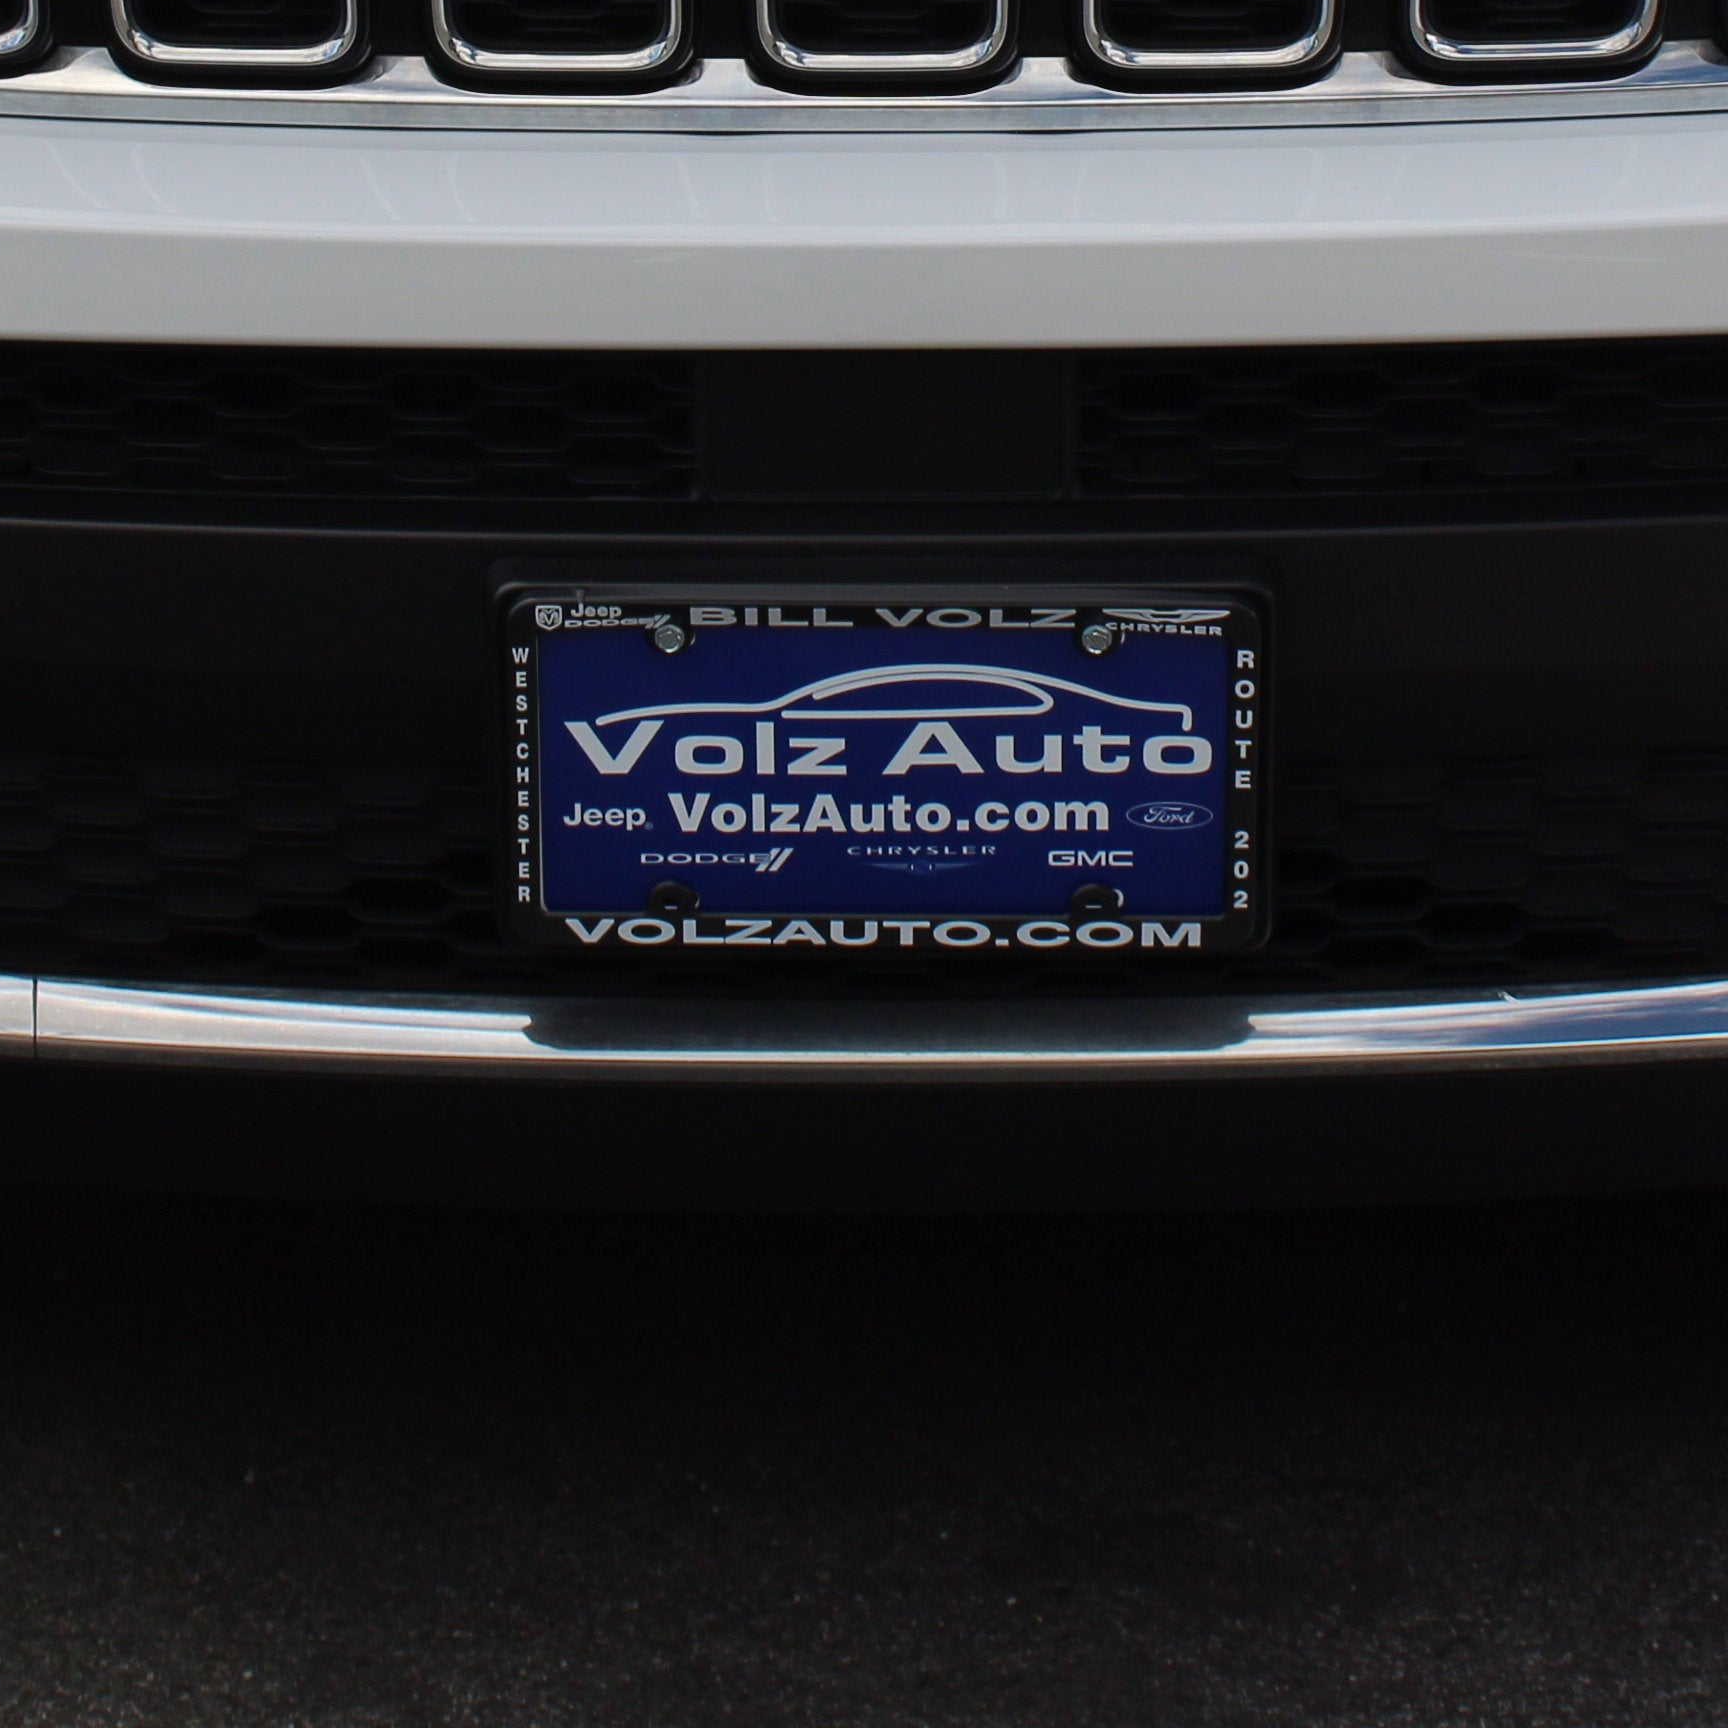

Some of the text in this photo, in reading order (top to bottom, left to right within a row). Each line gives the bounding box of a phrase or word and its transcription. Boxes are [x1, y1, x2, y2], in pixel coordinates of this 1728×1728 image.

[570, 603, 622, 619] Jeep
[689, 607, 1077, 628] BILL VOLZ
[1104, 621, 1223, 637] CHRYSLER
[564, 721, 1213, 775] Volz Auto
[511, 646, 531, 903] WESTCHESTER
[1233, 649, 1256, 909] ROUTE 202
[563, 802, 647, 831] Jeep
[667, 792, 1110, 833] VolzAuto.com
[1143, 805, 1196, 824] Ford
[640, 852, 772, 865] DODGE
[846, 845, 997, 856] CHRYSLER
[1047, 849, 1134, 867] GMC
[565, 917, 1202, 948] VOLZAUTO.COM
